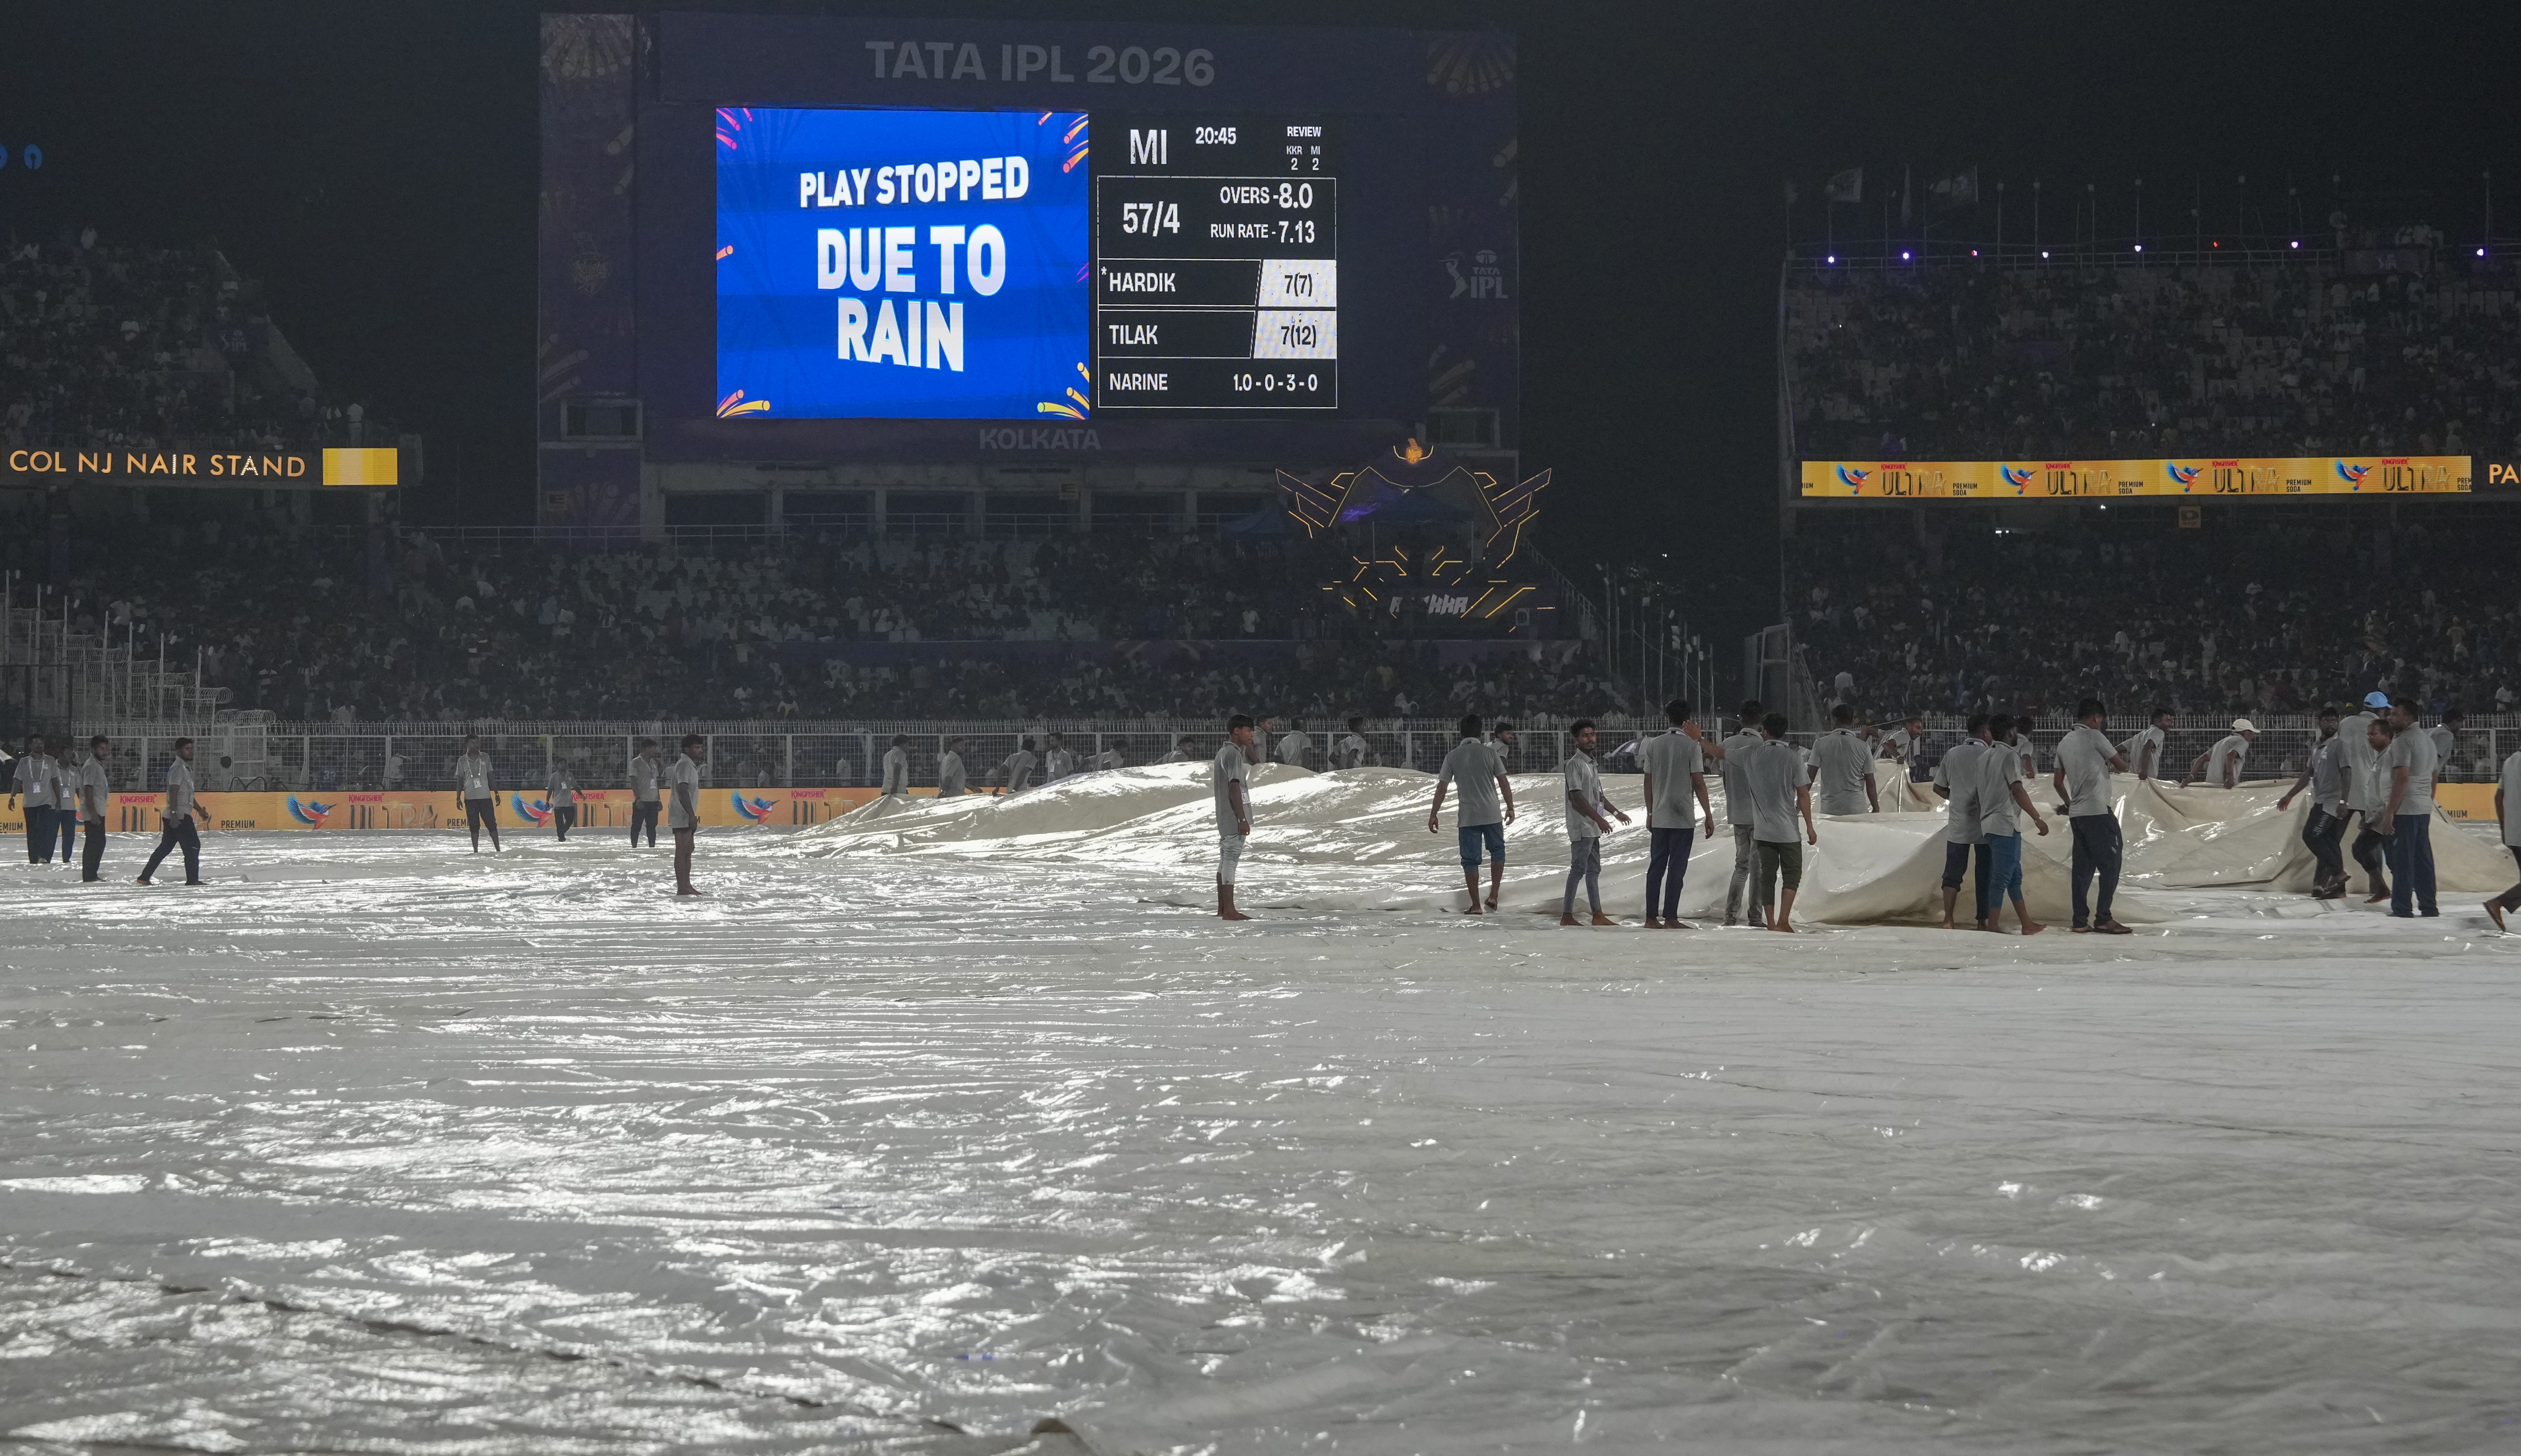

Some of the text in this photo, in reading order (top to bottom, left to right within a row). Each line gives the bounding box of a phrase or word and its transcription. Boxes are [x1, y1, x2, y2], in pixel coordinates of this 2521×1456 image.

[865, 40, 1215, 87] TATA IPL 2026
[1195, 127, 1236, 145] 20:45
[1287, 126, 1322, 138] REVIEW
[1130, 129, 1167, 165] MI
[1286, 145, 1320, 155] KKR MI
[1291, 158, 1319, 171] 2 2
[800, 156, 1029, 207] PLAY STOPPED
[1220, 186, 1270, 204] OVERS
[1123, 201, 1180, 237] 57/4
[1211, 224, 1235, 238] RUN
[1238, 224, 1268, 238] RATE
[817, 223, 1006, 296] DUE TO
[1472, 267, 1501, 275] TATA
[1284, 274, 1312, 297] 7(7)
[1471, 276, 1508, 299] IPL
[838, 296, 964, 372] RAIN
[1109, 325, 1317, 348] TILAK 7(12)
[1109, 373, 1168, 391] NARINE
[979, 428, 1101, 450] KOLKATA
[9, 450, 306, 477] COL NJ NAIR STAND
[2489, 464, 2521, 484] PA
[1881, 469, 1946, 495] ULTRA
[2046, 468, 2111, 495] ULTRA
[2212, 466, 2279, 493] ULTRA
[2382, 464, 2450, 491] ULTRA
[120, 795, 155, 804] KINGFISHER
[348, 794, 382, 802] KINGFISHER
[791, 790, 825, 799] KINGFISHER
